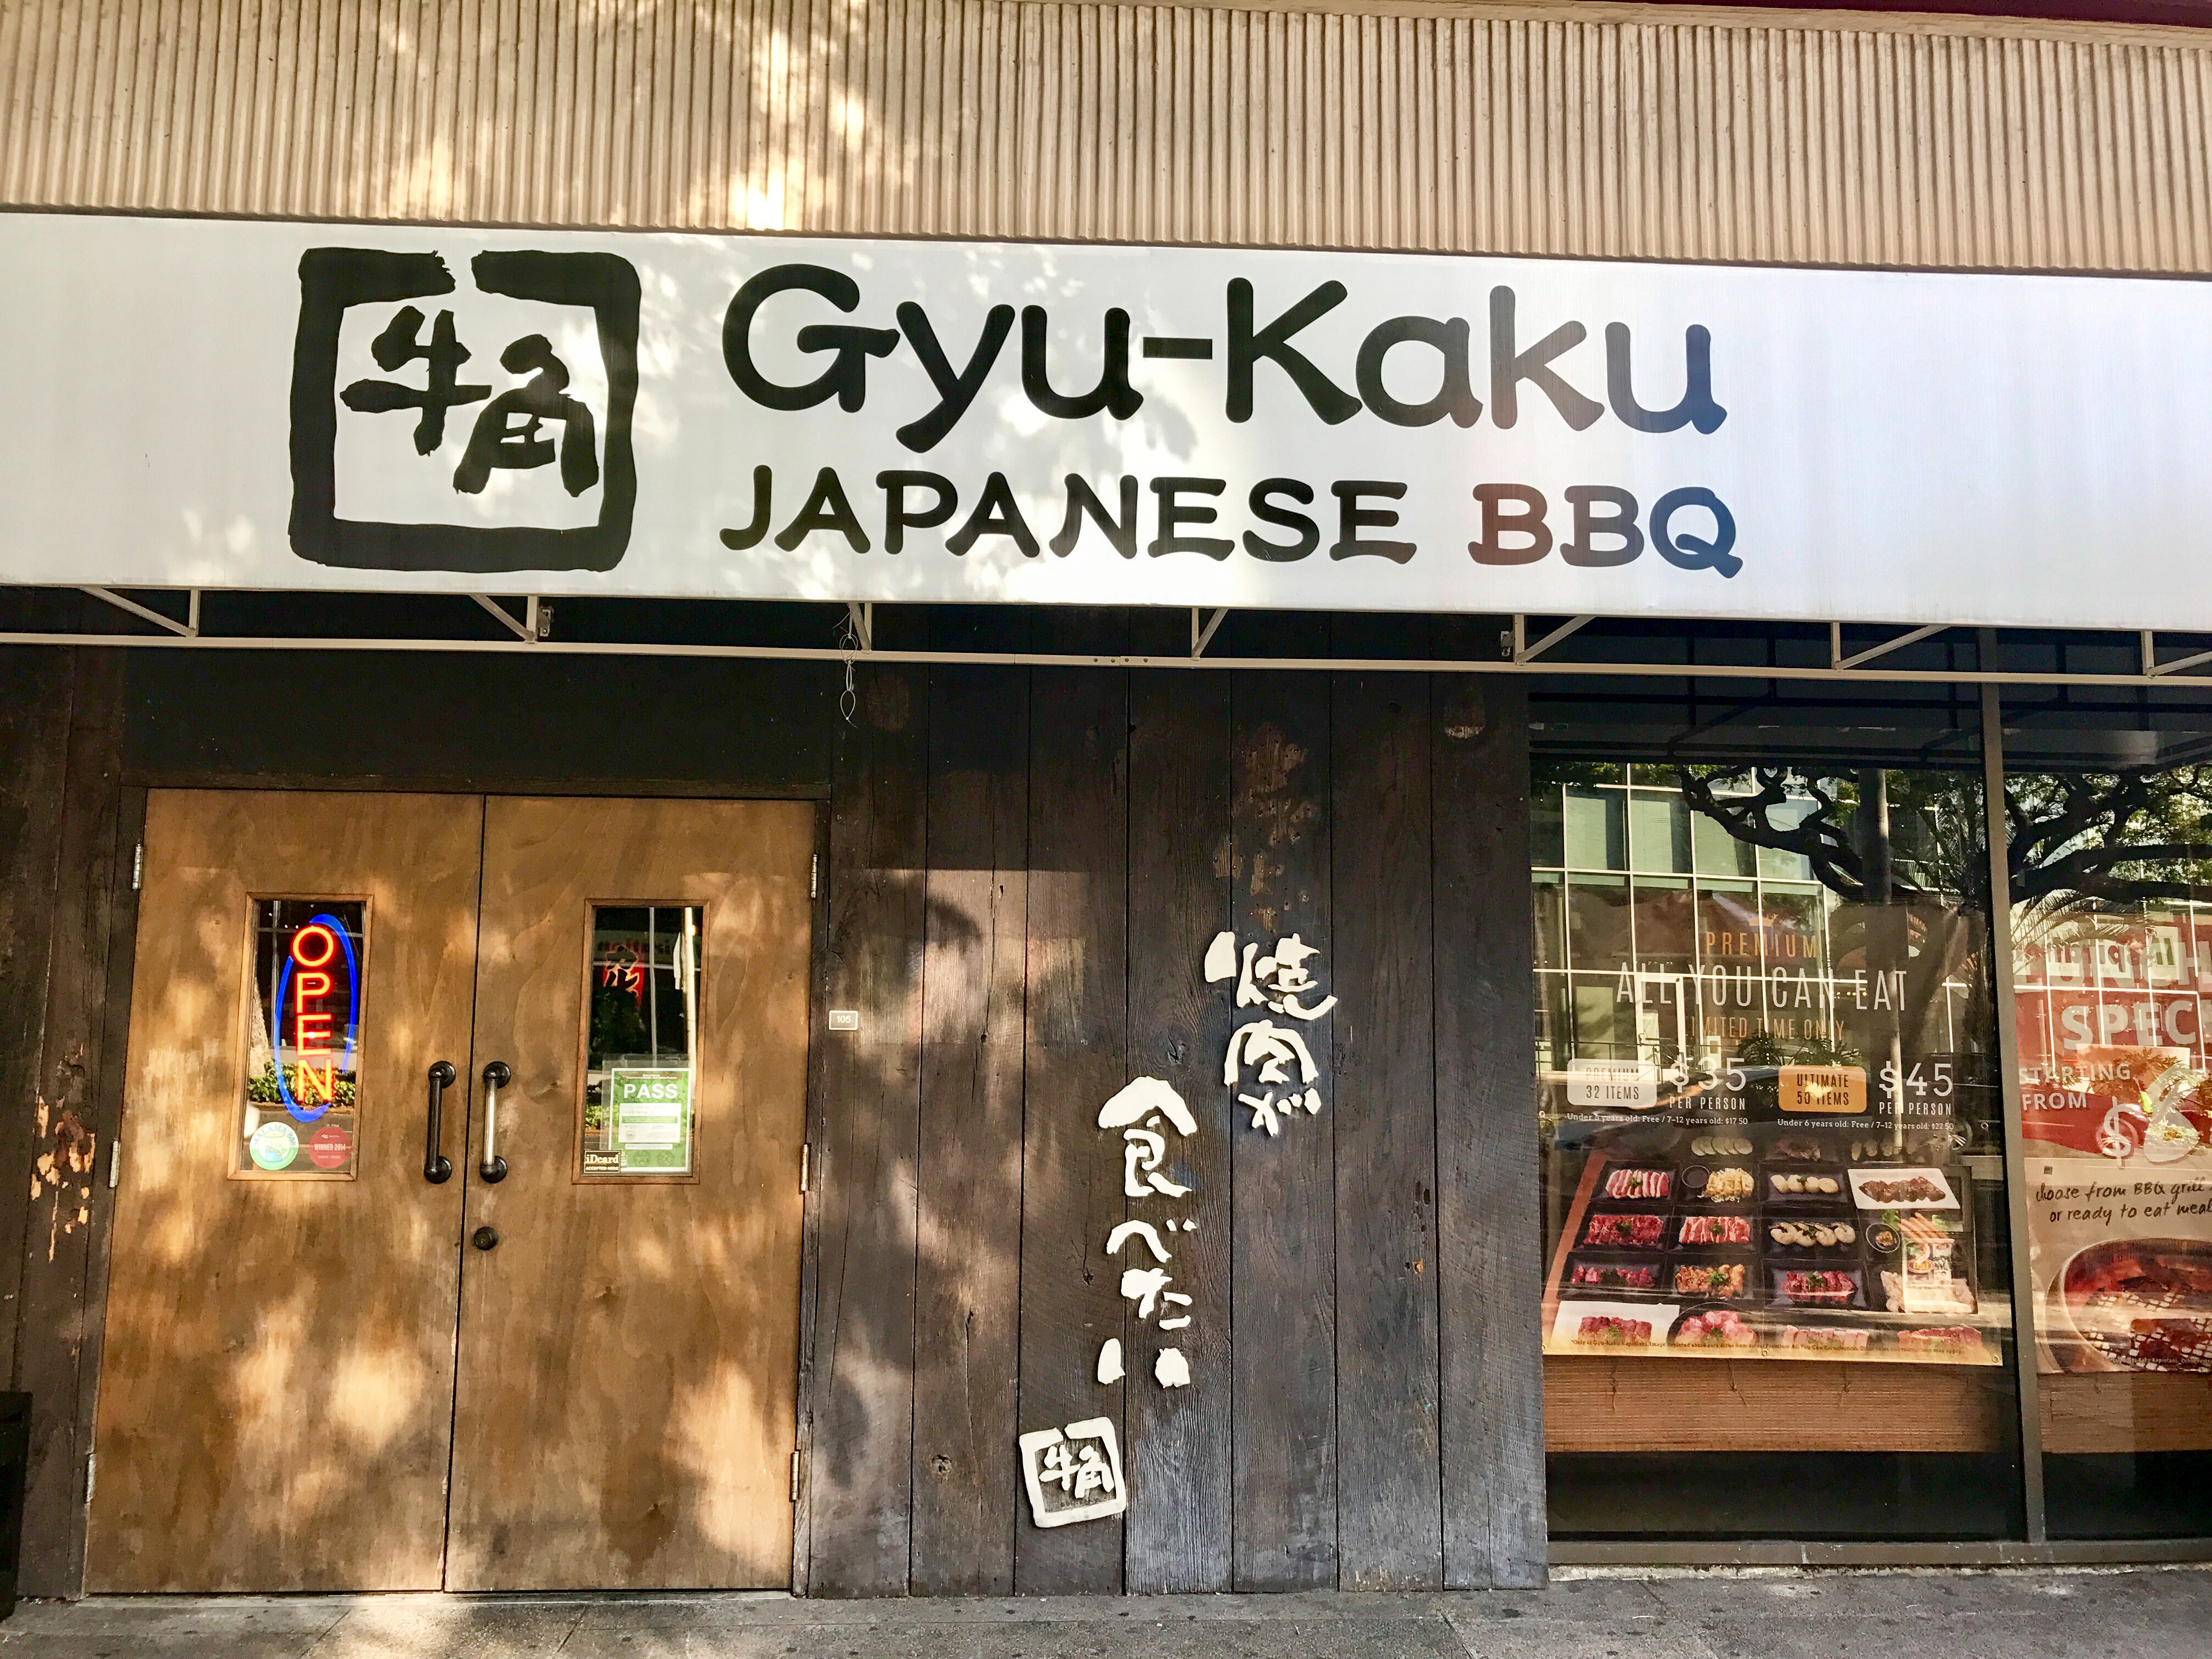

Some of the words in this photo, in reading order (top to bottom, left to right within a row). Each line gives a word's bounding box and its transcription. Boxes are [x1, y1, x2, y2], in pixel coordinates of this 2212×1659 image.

[722, 263, 1728, 453] Gyu-Kaku
[340, 305, 599, 497] 牛角
[719, 464, 1417, 565] JAPANESE
[1467, 483, 1743, 579] BBQ
[1706, 931, 1817, 958] PREMIUM
[1616, 962, 1672, 1005] ALL
[1688, 964, 1752, 1007] YOU
[1772, 966, 1834, 1008] CAN
[1855, 969, 1907, 1011] EAT
[291, 924, 334, 1103] OPEN
[836, 1015, 851, 1024] 105
[1685, 1016, 1747, 1038] IMITED
[1756, 1018, 1795, 1039] TIME
[1586, 1067, 1639, 1081] PREMIUM
[1670, 1054, 1747, 1093] $35
[1797, 1073, 1849, 1088] ULTIMATE
[1879, 1061, 1953, 1099] $45
[2018, 1063, 2130, 1084] STARTING
[623, 1083, 678, 1099] PASS
[1586, 1085, 1600, 1099] 32
[1606, 1085, 1639, 1100] ITEMS
[1797, 1092, 1810, 1105] 50
[1816, 1092, 1849, 1105] ITEMS
[2021, 1092, 2087, 1110] FROM
[1669, 1097, 1692, 1109] PER
[1700, 1097, 1746, 1110] PERSON
[1879, 1102, 1903, 1114] PER
[1909, 1102, 1951, 1115] PERSON
[1567, 1113, 1592, 1121] Under
[1601, 1115, 1624, 1123] years
[1625, 1114, 1640, 1122] old:
[1777, 1119, 1803, 1127] Under
[2036, 1183, 2081, 1201] choose
[2085, 1181, 2126, 1202] from
[2134, 1181, 2166, 1195] BBQ
[2049, 1210, 2061, 1222] or
[2067, 1206, 2113, 1227] ready
[2120, 1204, 2137, 1219] to
[2144, 1201, 2170, 1217] eat
